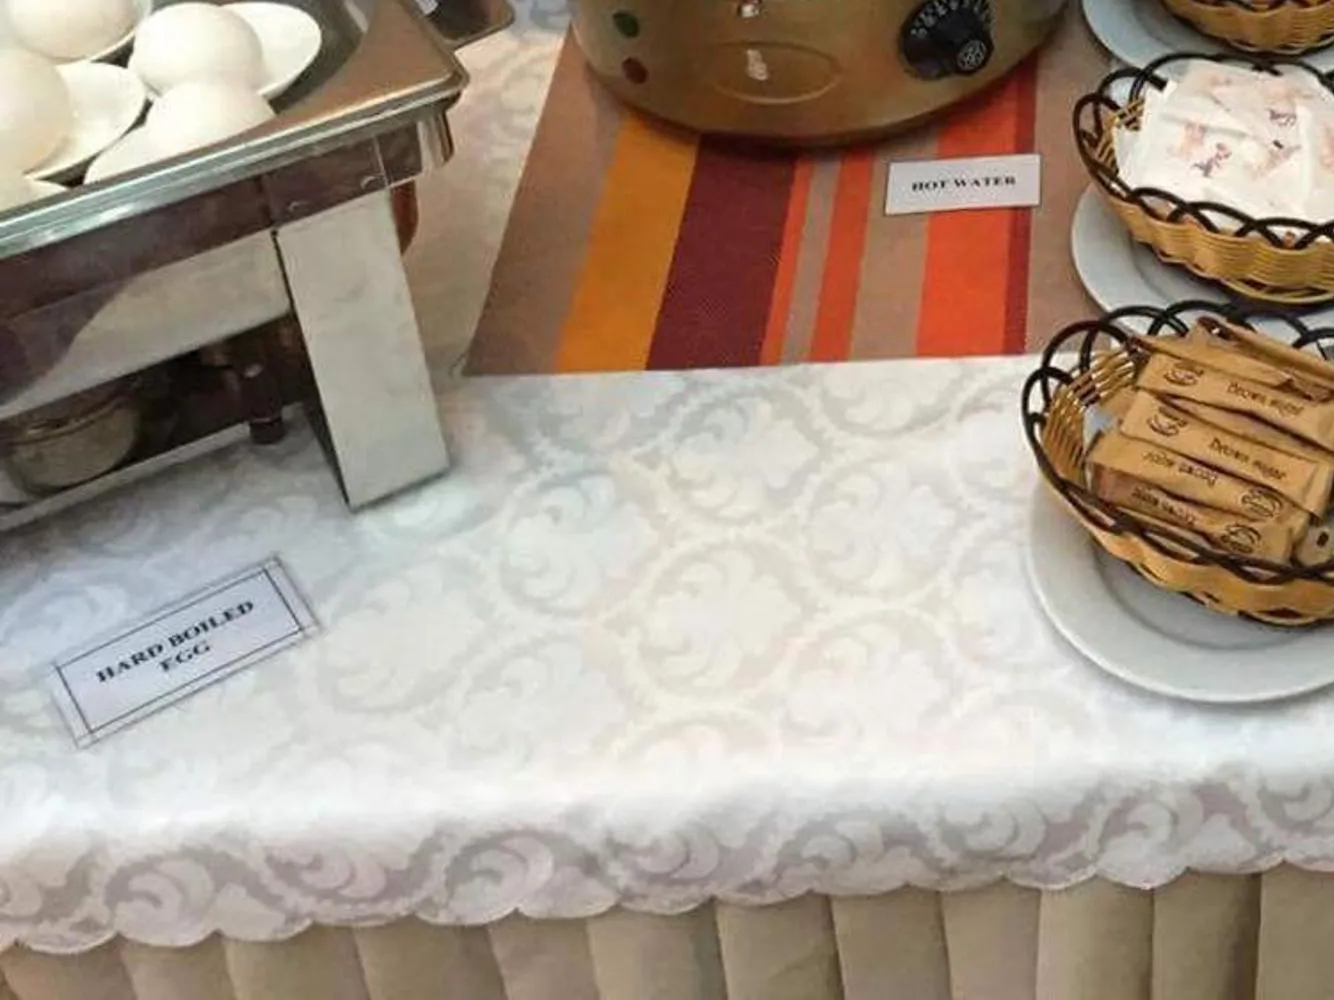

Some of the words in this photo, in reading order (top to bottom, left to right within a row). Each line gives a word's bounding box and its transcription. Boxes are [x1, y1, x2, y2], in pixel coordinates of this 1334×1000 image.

[911, 179, 948, 192] HOT
[953, 175, 1017, 189] WATER
[95, 643, 163, 683] HARD
[167, 600, 255, 648] BOILED
[159, 640, 211, 673] EGG
